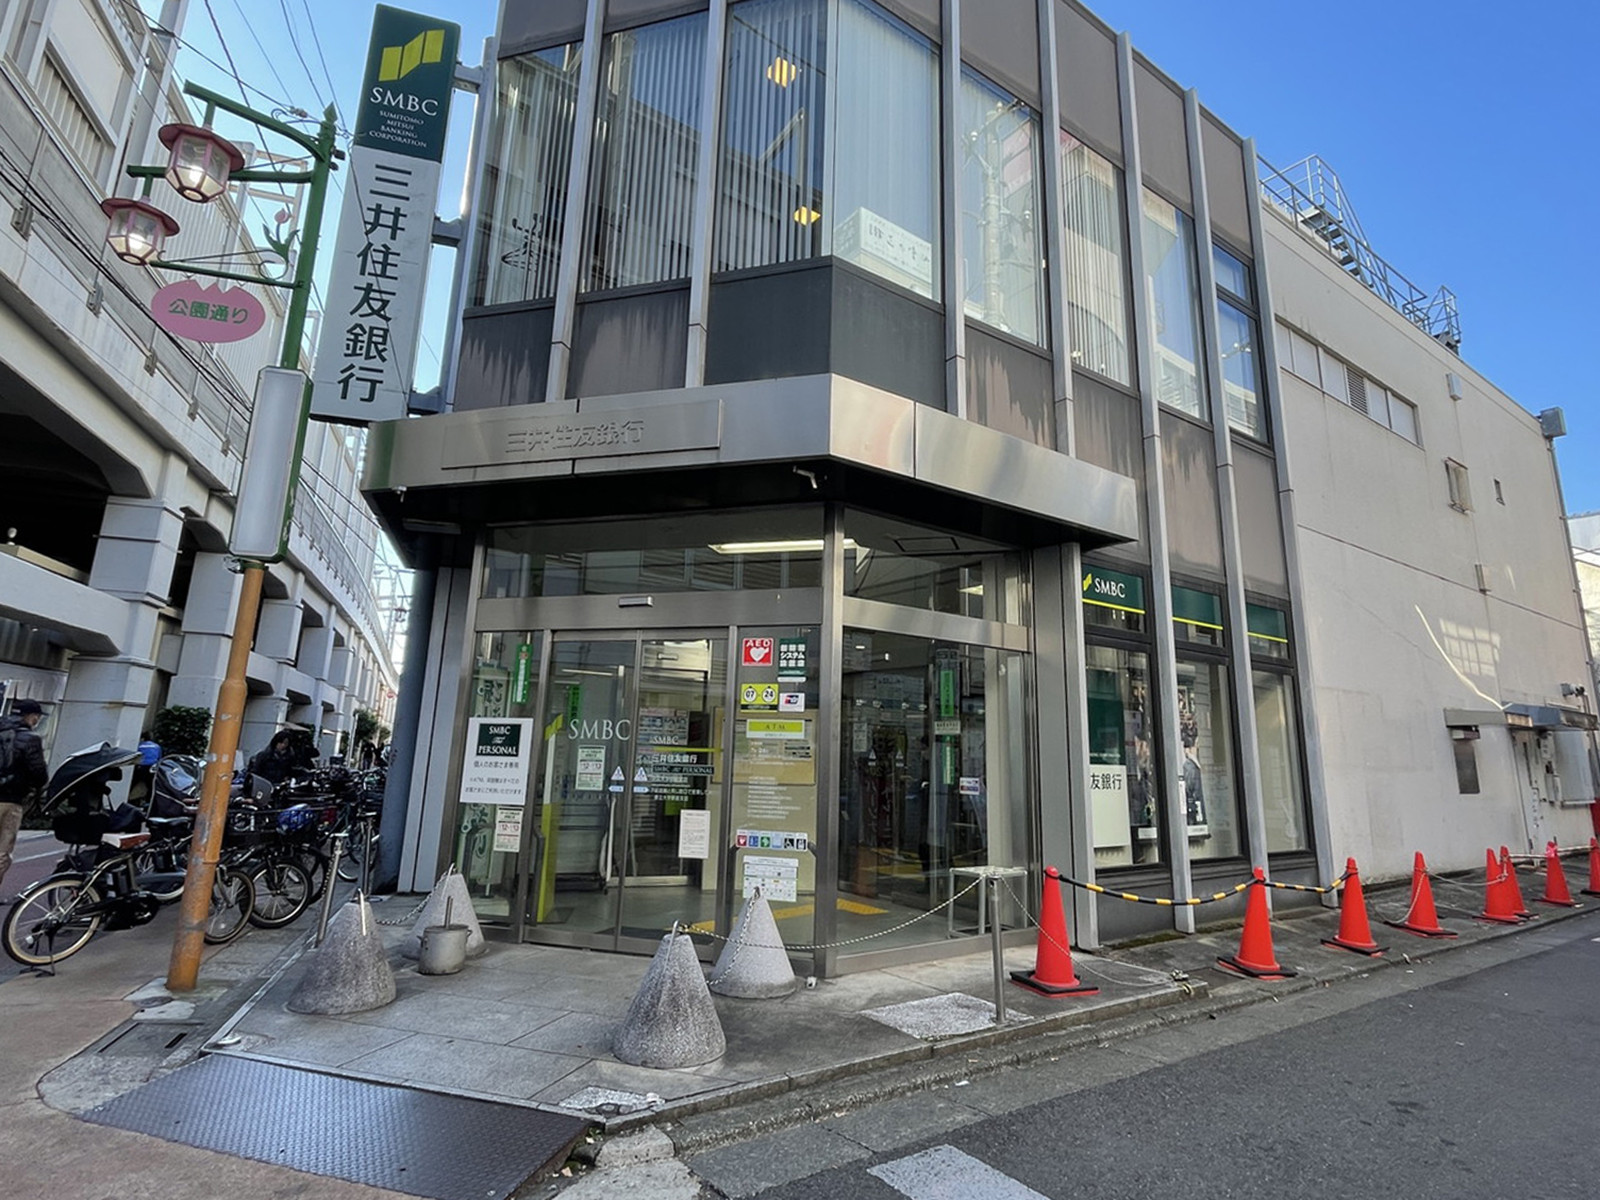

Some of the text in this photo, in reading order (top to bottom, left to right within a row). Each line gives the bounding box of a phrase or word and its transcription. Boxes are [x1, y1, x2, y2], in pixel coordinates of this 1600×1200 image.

[370, 87, 439, 116] SMBC
[380, 110, 424, 125] SUMITOMO
[386, 120, 414, 130] MITSUI
[369, 130, 427, 147] CORPORATION
[381, 125, 418, 138] BANKING
[337, 164, 412, 403] 三井住友銀行
[168, 298, 248, 324] 公園通り
[506, 419, 644, 454] 三井住友銀行
[1094, 578, 1126, 598] SMBC
[488, 726, 511, 734] SMBC
[568, 719, 631, 740] SMBC
[653, 735, 679, 745] SMBC
[478, 745, 517, 754] PERSONAL
[1090, 773, 1122, 790] 友銀行
